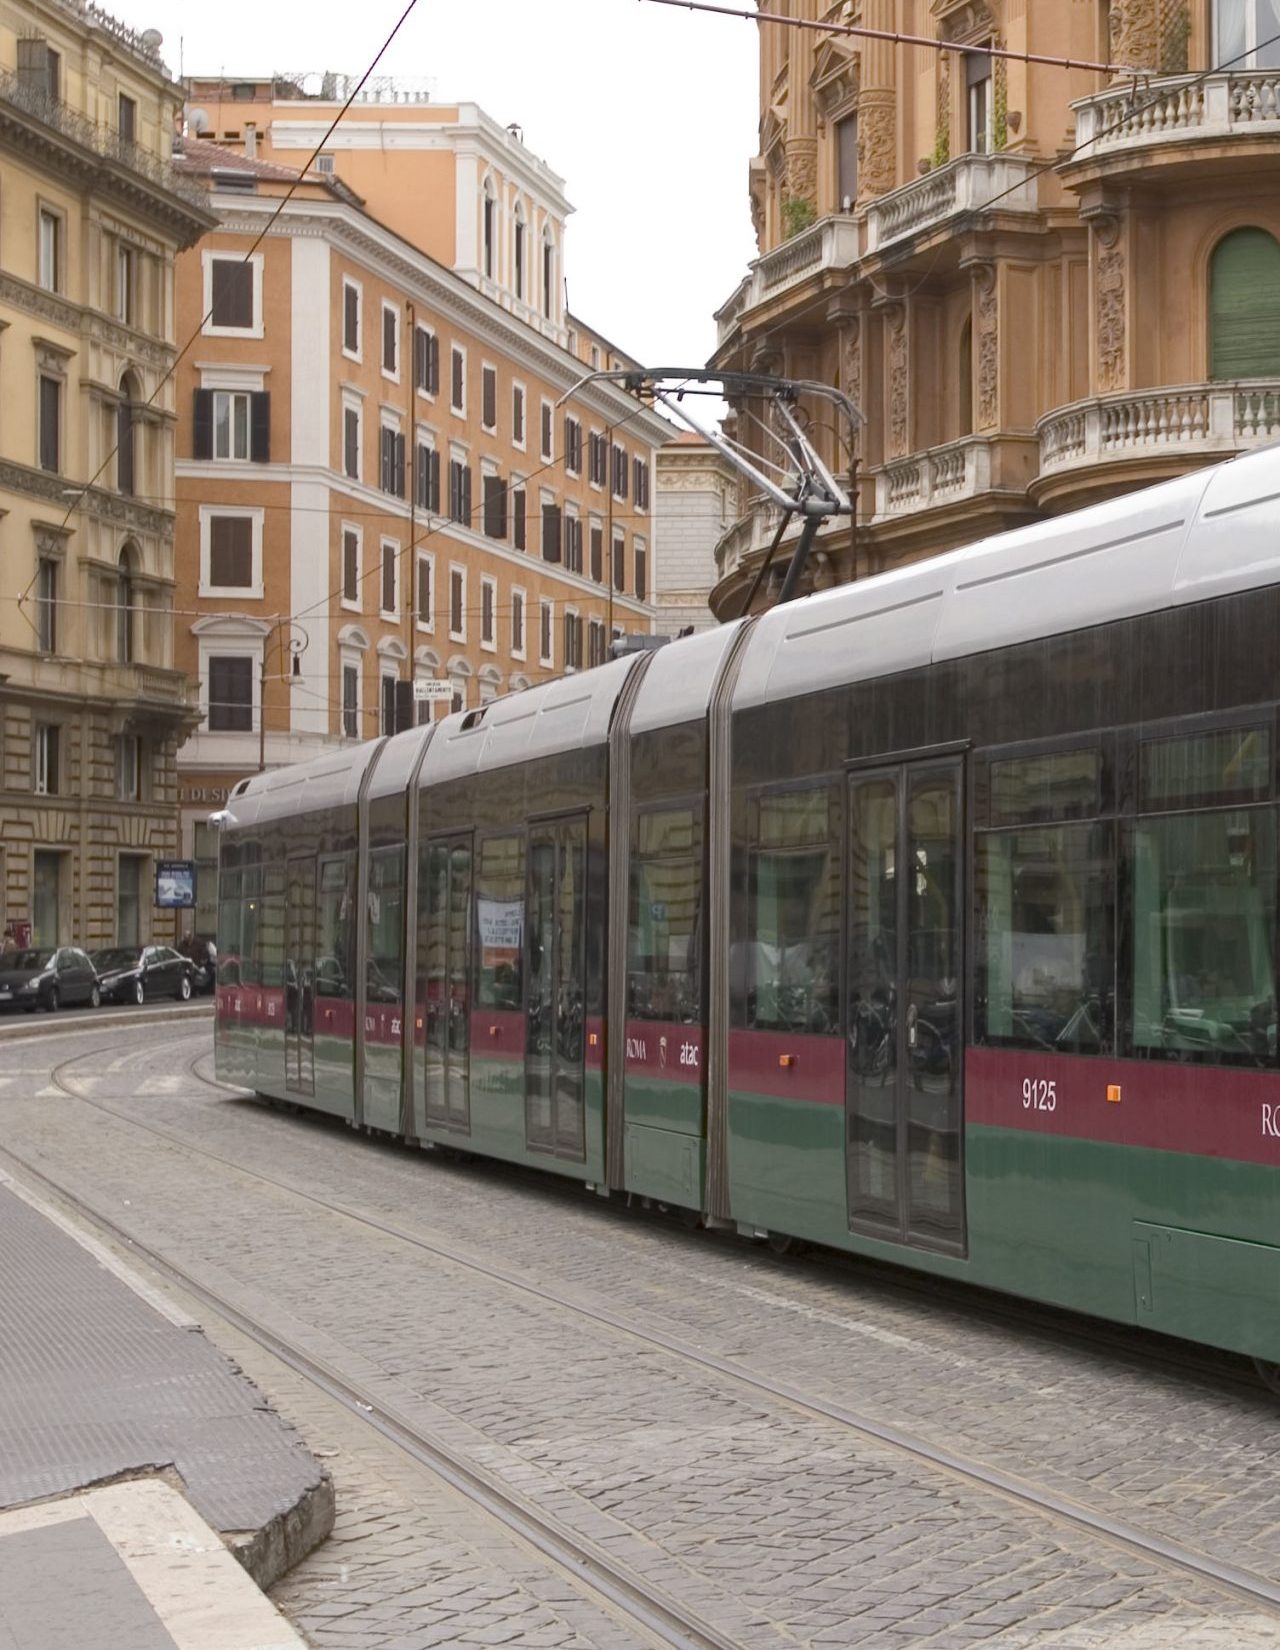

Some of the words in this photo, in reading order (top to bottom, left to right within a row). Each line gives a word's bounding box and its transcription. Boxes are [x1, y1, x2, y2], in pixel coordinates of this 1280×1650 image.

[191, 789, 206, 801] DI
[680, 1041, 699, 1066] atac
[1022, 1078, 1056, 1112] 9125
